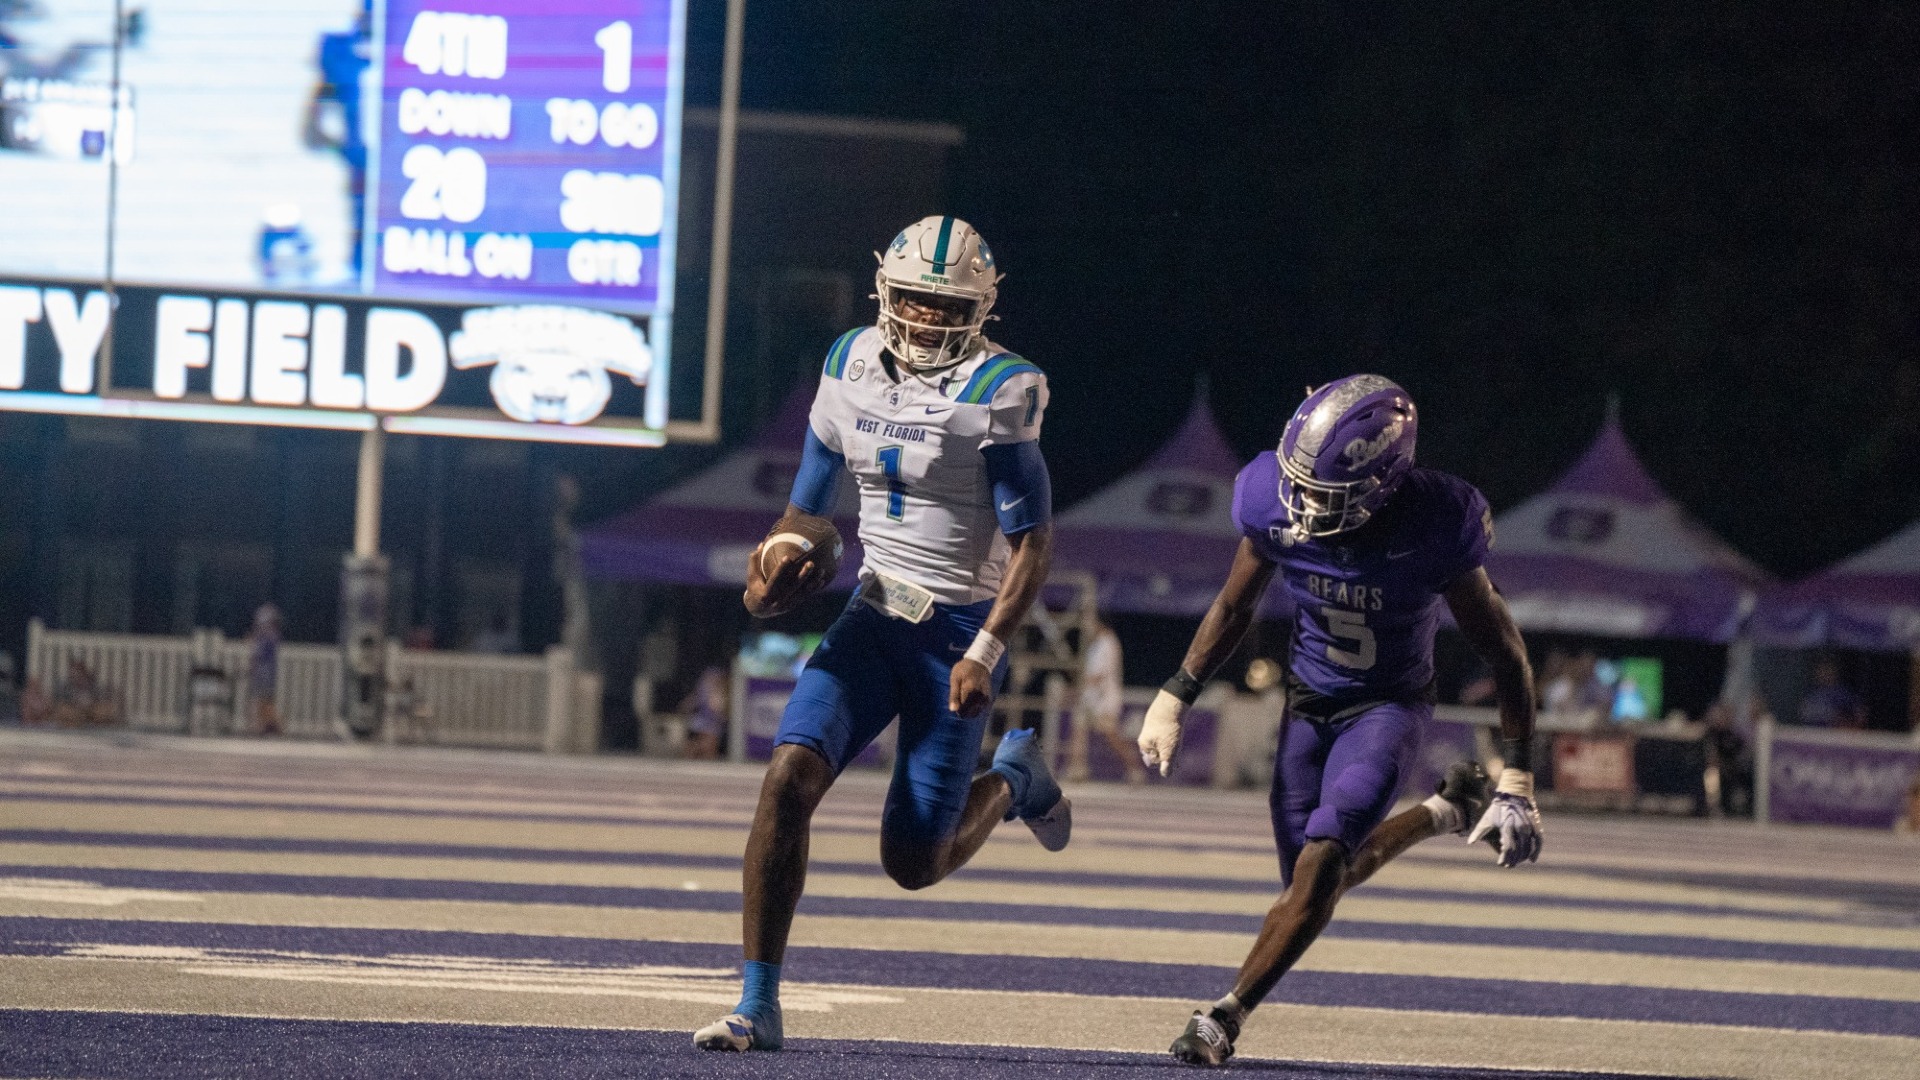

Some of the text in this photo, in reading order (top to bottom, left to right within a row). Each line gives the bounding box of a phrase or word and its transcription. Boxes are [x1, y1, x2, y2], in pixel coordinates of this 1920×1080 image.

[595, 21, 632, 92] 1
[399, 88, 511, 139] DOWN
[546, 98, 658, 148] TO GO
[401, 145, 486, 222] 20
[384, 226, 532, 279] BALL ON
[568, 238, 642, 286] QTR
[921, 274, 949, 285] ARETE
[153, 295, 447, 411] FIELD
[856, 418, 926, 443] WEST FLORIDA
[1024, 384, 1039, 427] 1
[876, 444, 906, 522] 1
[1308, 574, 1383, 611] BEARS
[1321, 606, 1377, 670] 5
